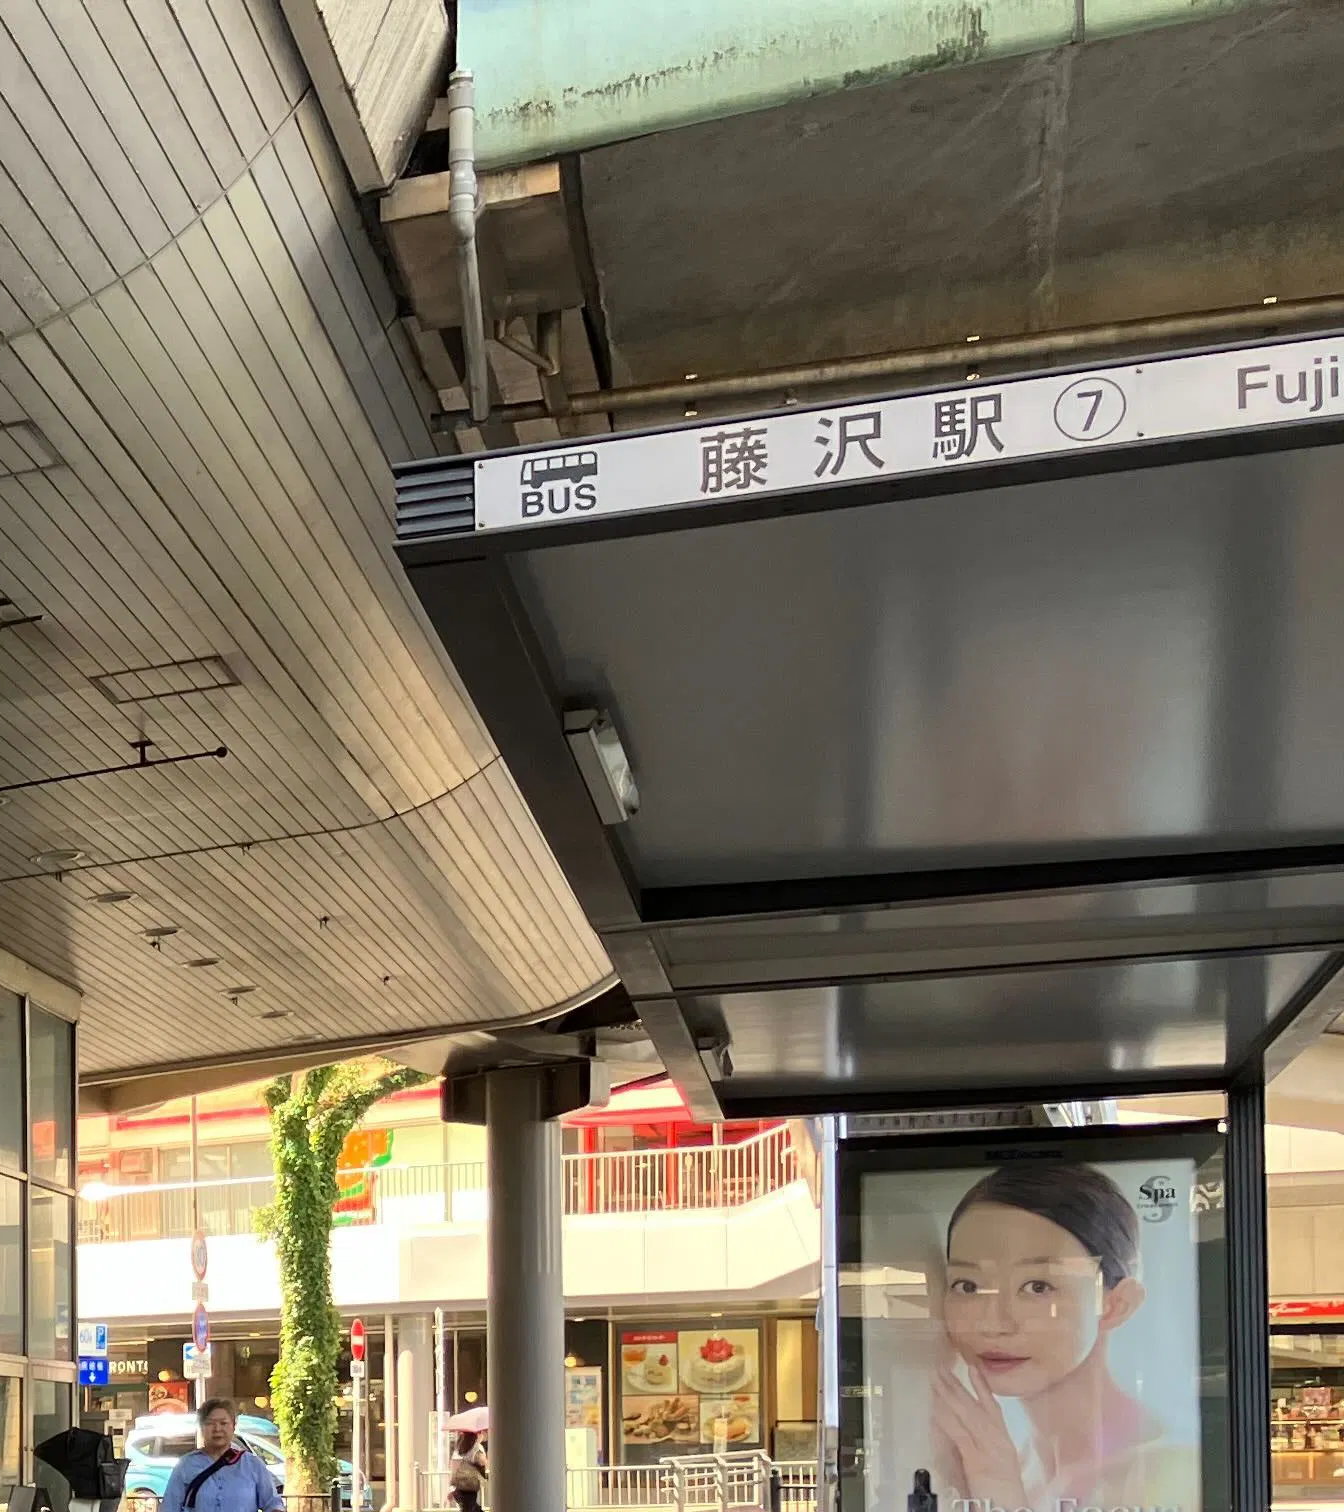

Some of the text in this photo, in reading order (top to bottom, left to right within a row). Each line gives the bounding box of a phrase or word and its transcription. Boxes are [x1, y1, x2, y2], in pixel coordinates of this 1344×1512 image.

[699, 392, 1005, 497] 藤沢駅
[520, 487, 599, 519] BUS
[1139, 1184, 1176, 1206] Spa
[109, 1360, 149, 1375] RONT
